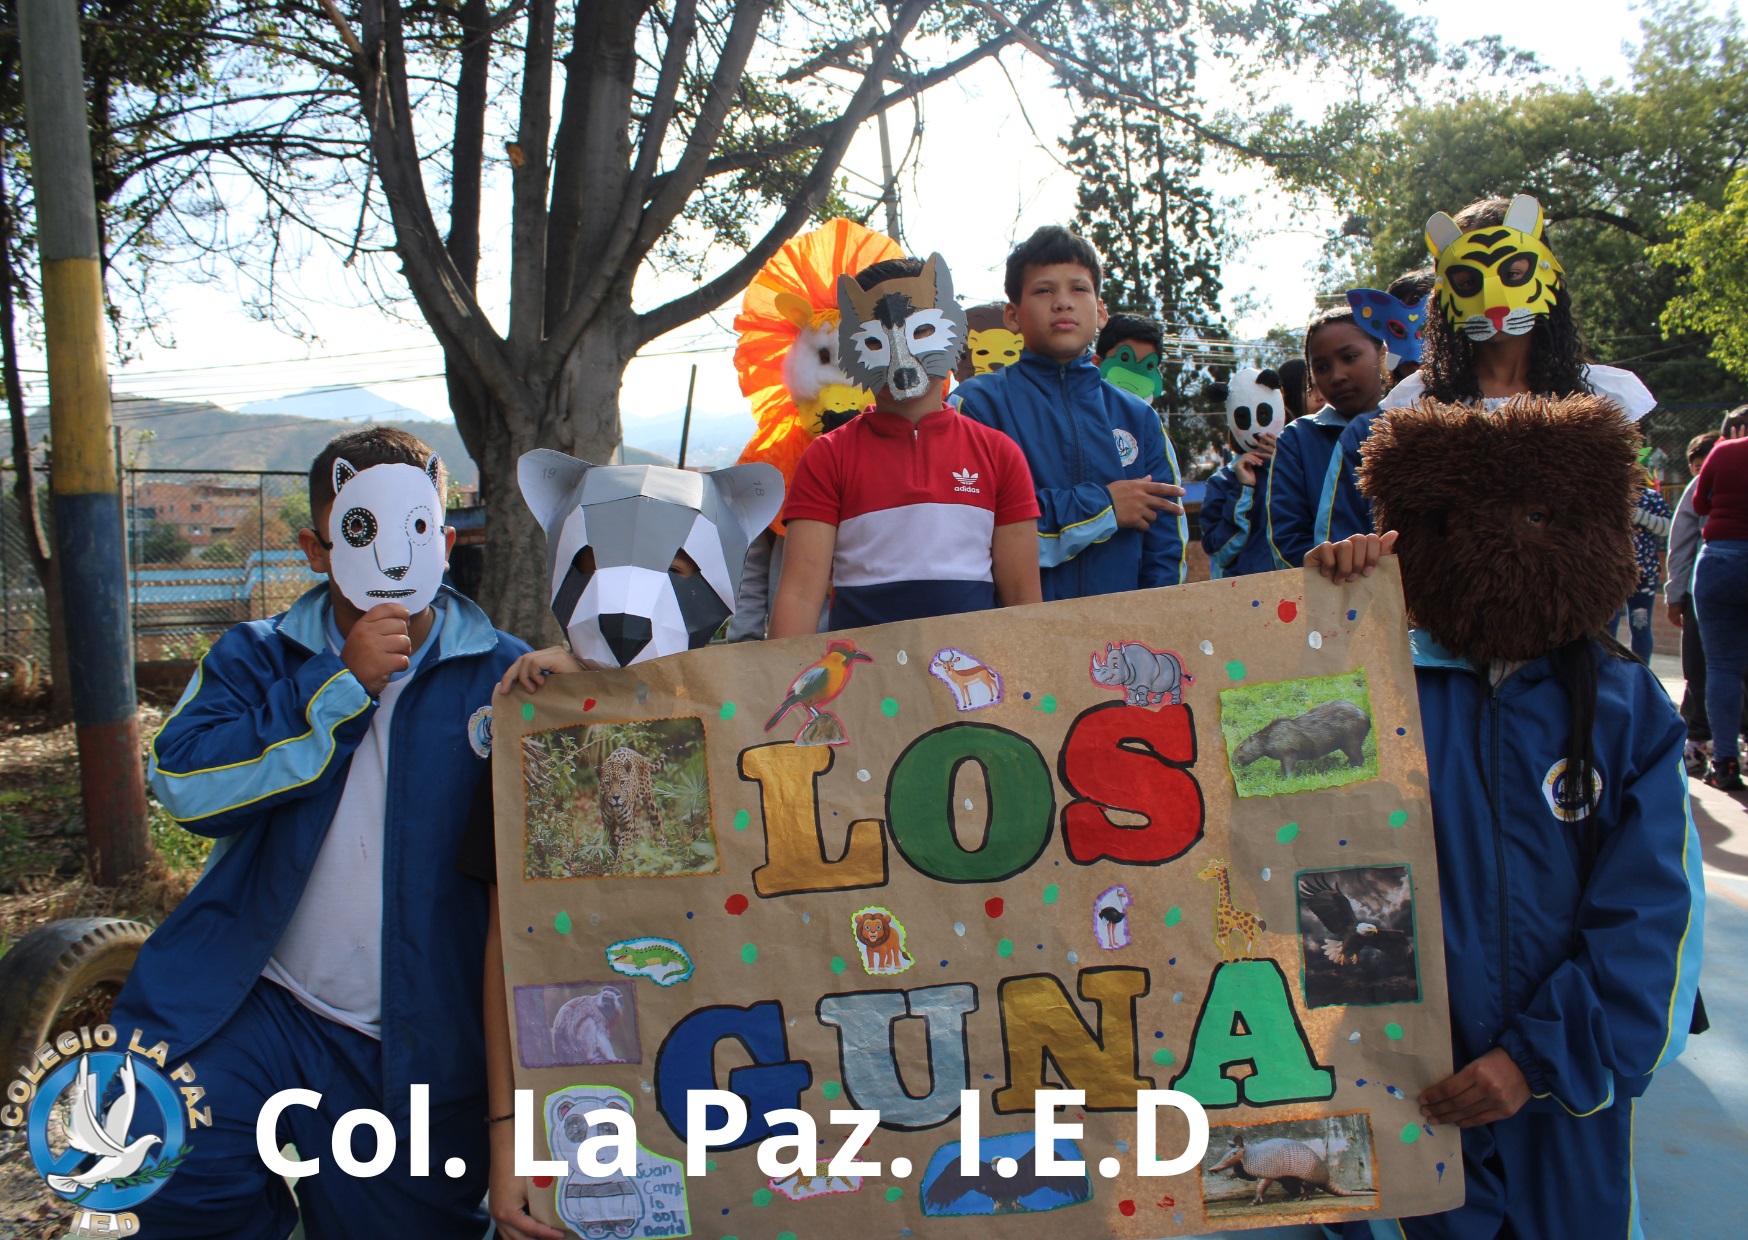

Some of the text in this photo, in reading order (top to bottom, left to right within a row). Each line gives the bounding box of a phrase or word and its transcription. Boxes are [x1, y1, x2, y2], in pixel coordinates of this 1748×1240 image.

[542, 467, 557, 480] 19
[753, 480, 765, 497] 18
[954, 485, 981, 494] adidas
[738, 700, 1206, 898] LOS
[653, 958, 1337, 1152] GUNA
